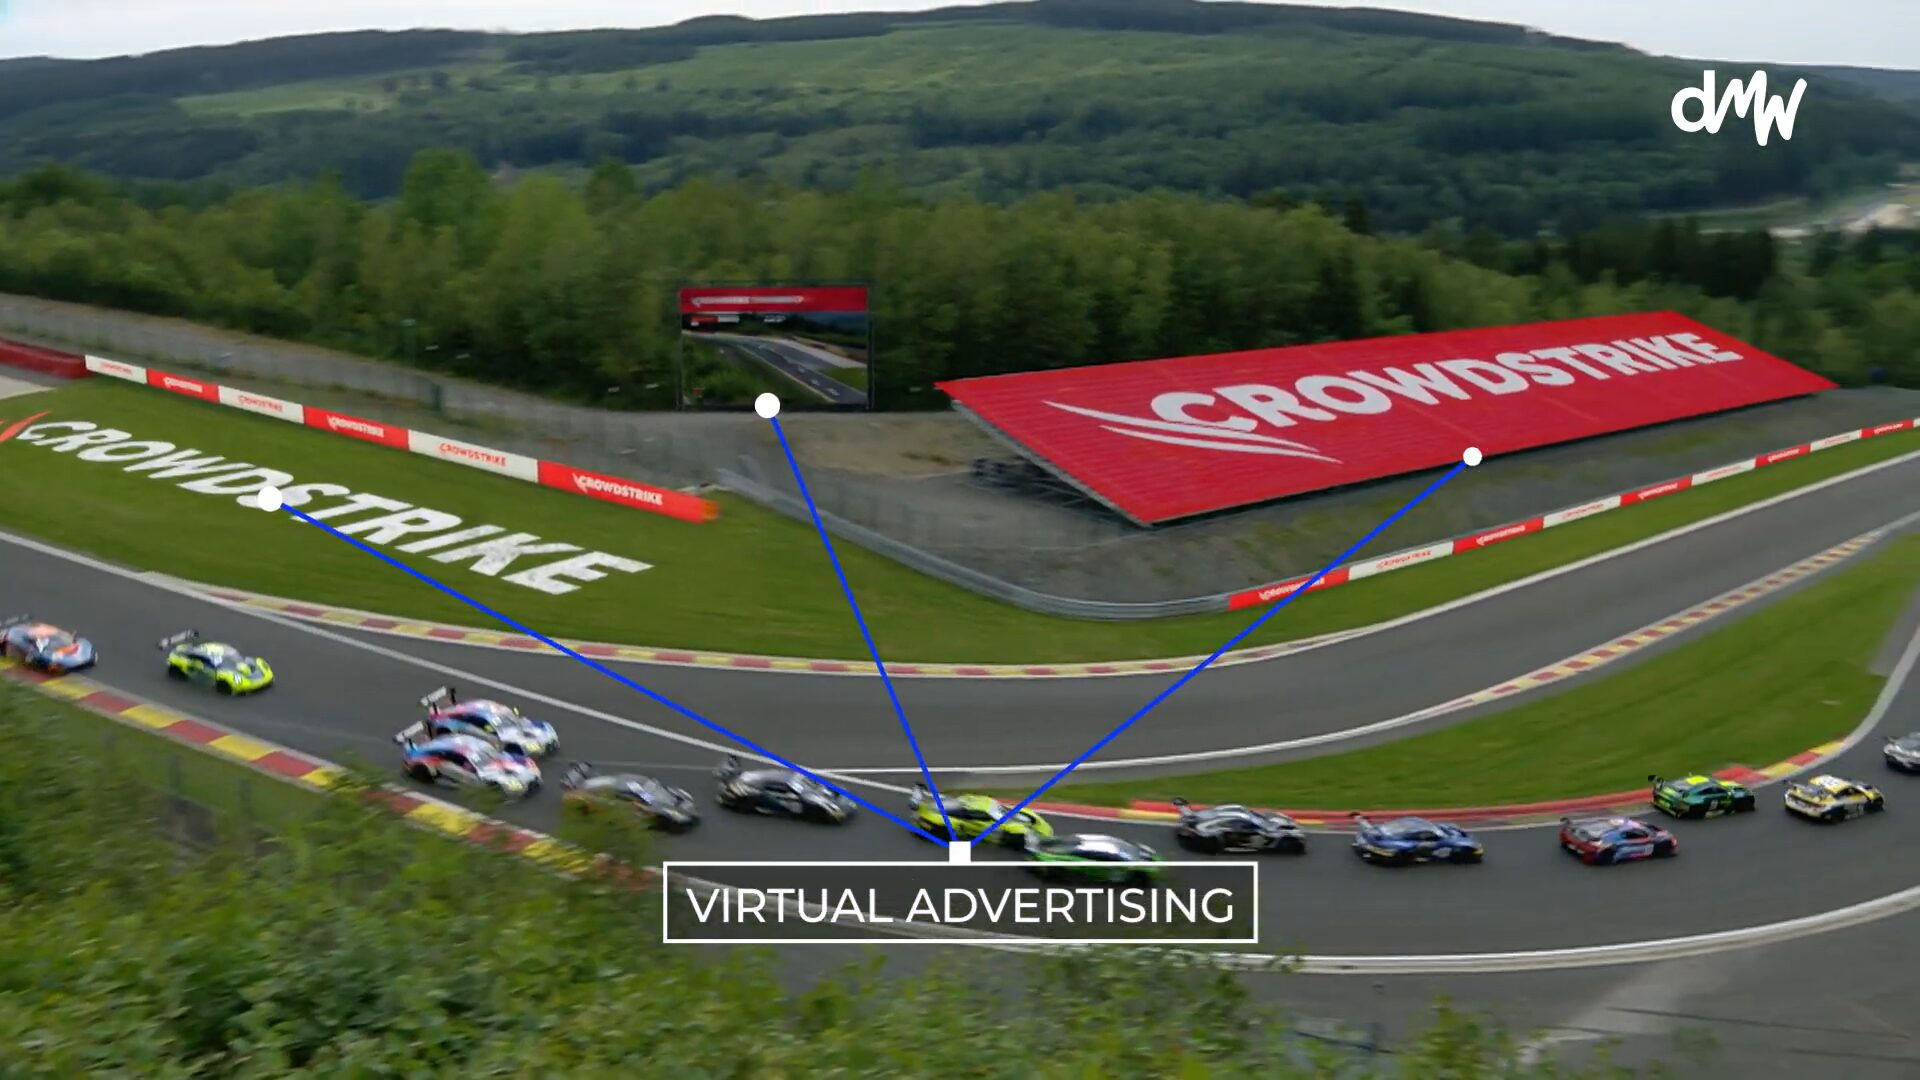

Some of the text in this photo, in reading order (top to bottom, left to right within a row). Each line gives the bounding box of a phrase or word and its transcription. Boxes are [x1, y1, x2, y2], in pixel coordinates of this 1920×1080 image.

[1150, 332, 1743, 432] CROWDSTRIKE
[439, 442, 507, 467] CROWDSTRIKE
[16, 421, 655, 595] CROWDSTRIKE
[576, 474, 663, 505] CROWDSTRIKE
